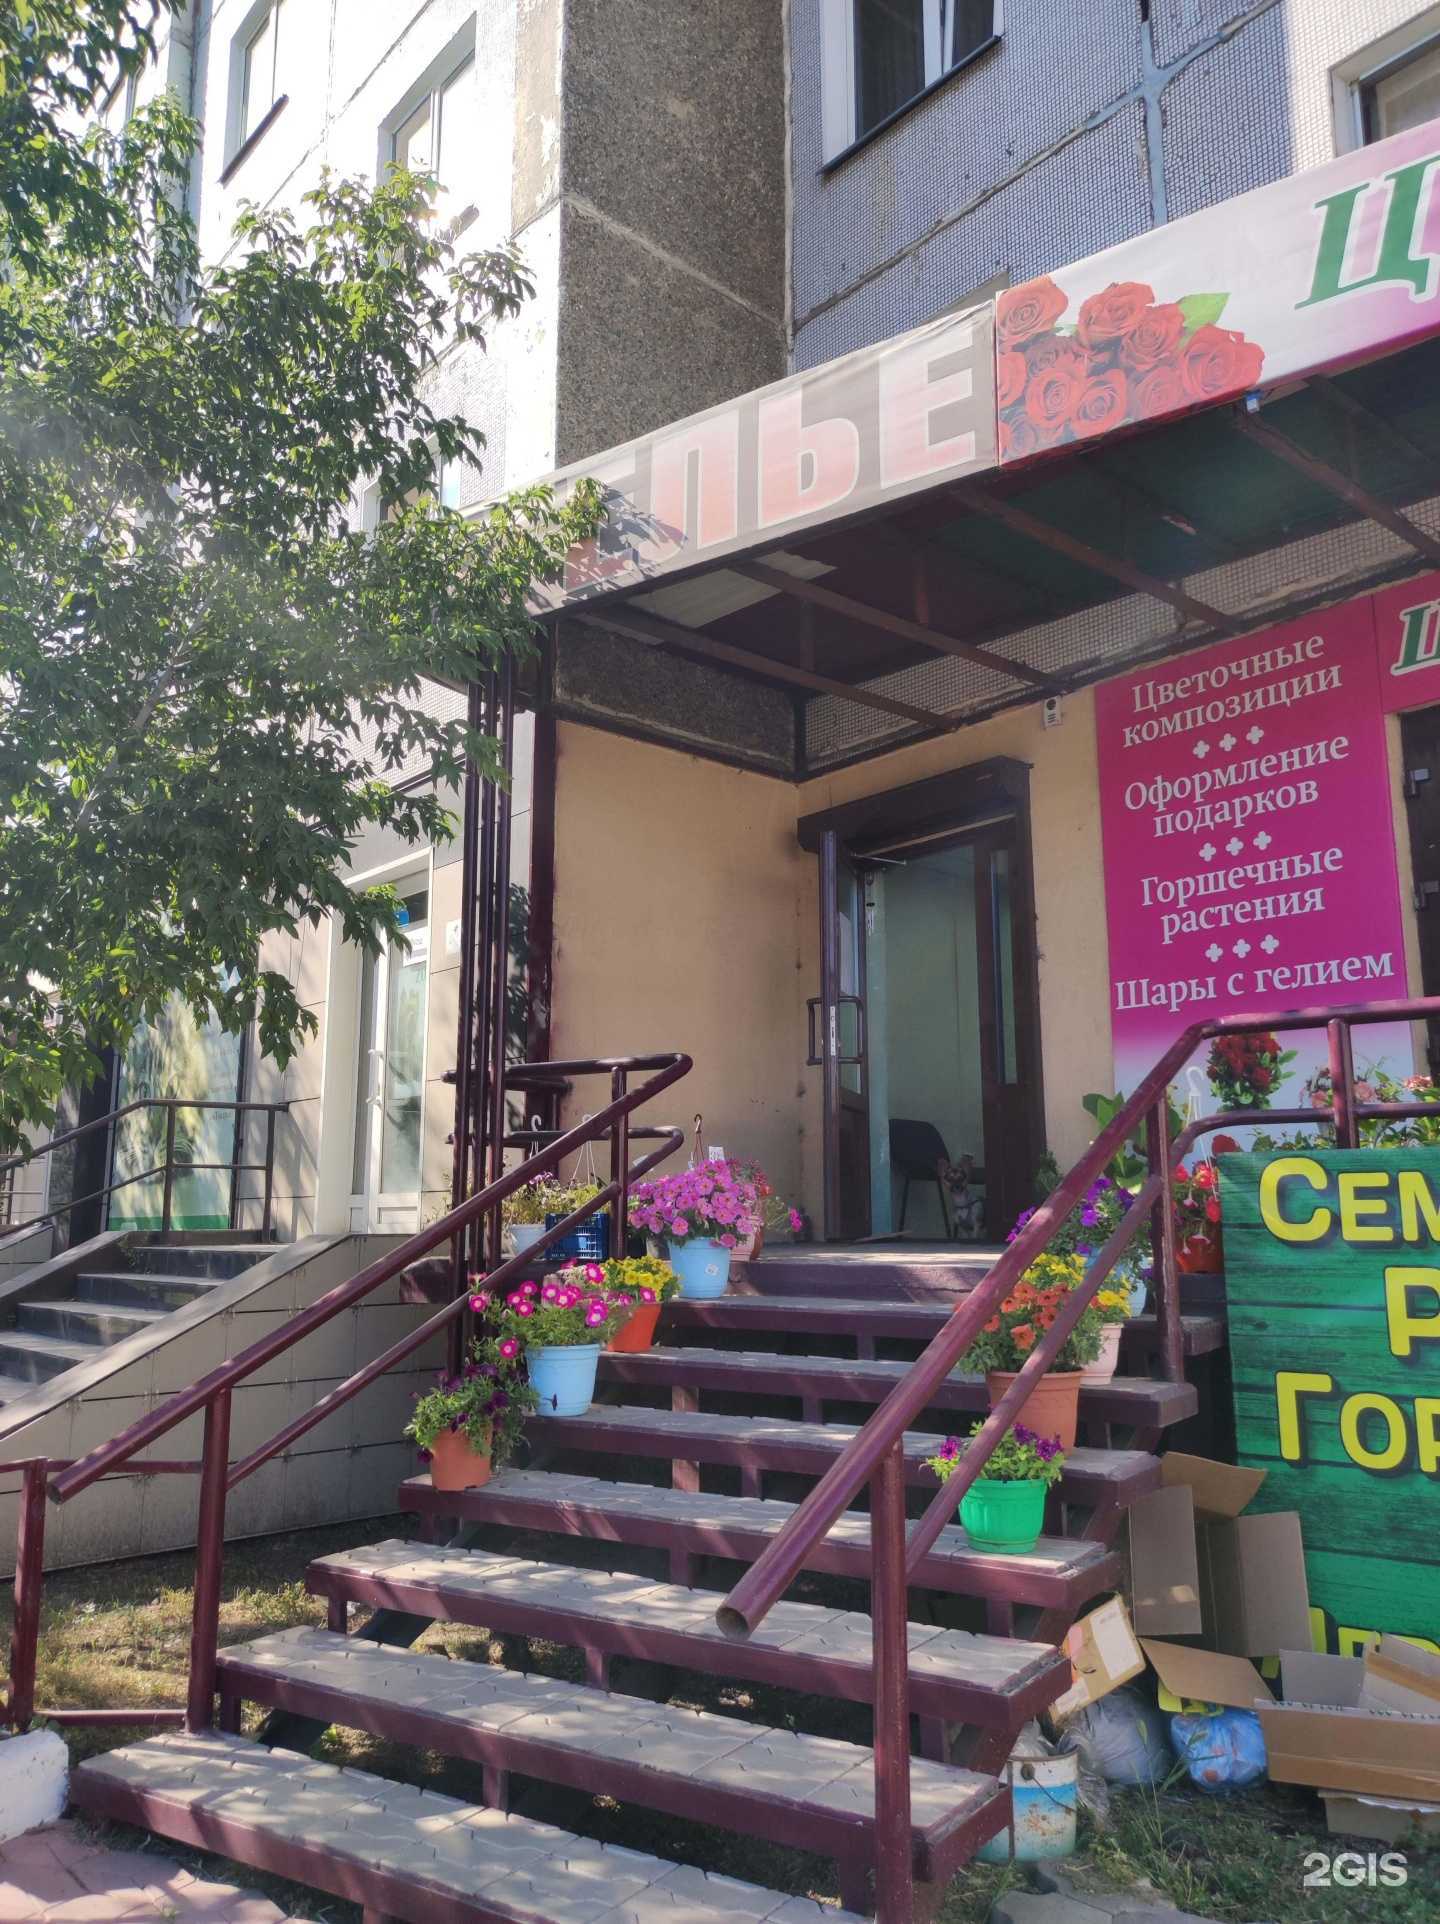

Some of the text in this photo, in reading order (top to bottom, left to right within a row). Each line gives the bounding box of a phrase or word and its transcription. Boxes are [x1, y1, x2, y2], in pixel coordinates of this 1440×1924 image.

[498, 318, 976, 610] ЕЛЬЕ
[1122, 664, 1343, 748] композиции
[1131, 635, 1325, 713] Цветочные
[1124, 735, 1350, 812] Оформление
[1153, 780, 1319, 838] подарков
[1141, 847, 1344, 908] Горшечные
[1161, 887, 1325, 945] растения
[1115, 952, 1395, 1012] Шары с гелием
